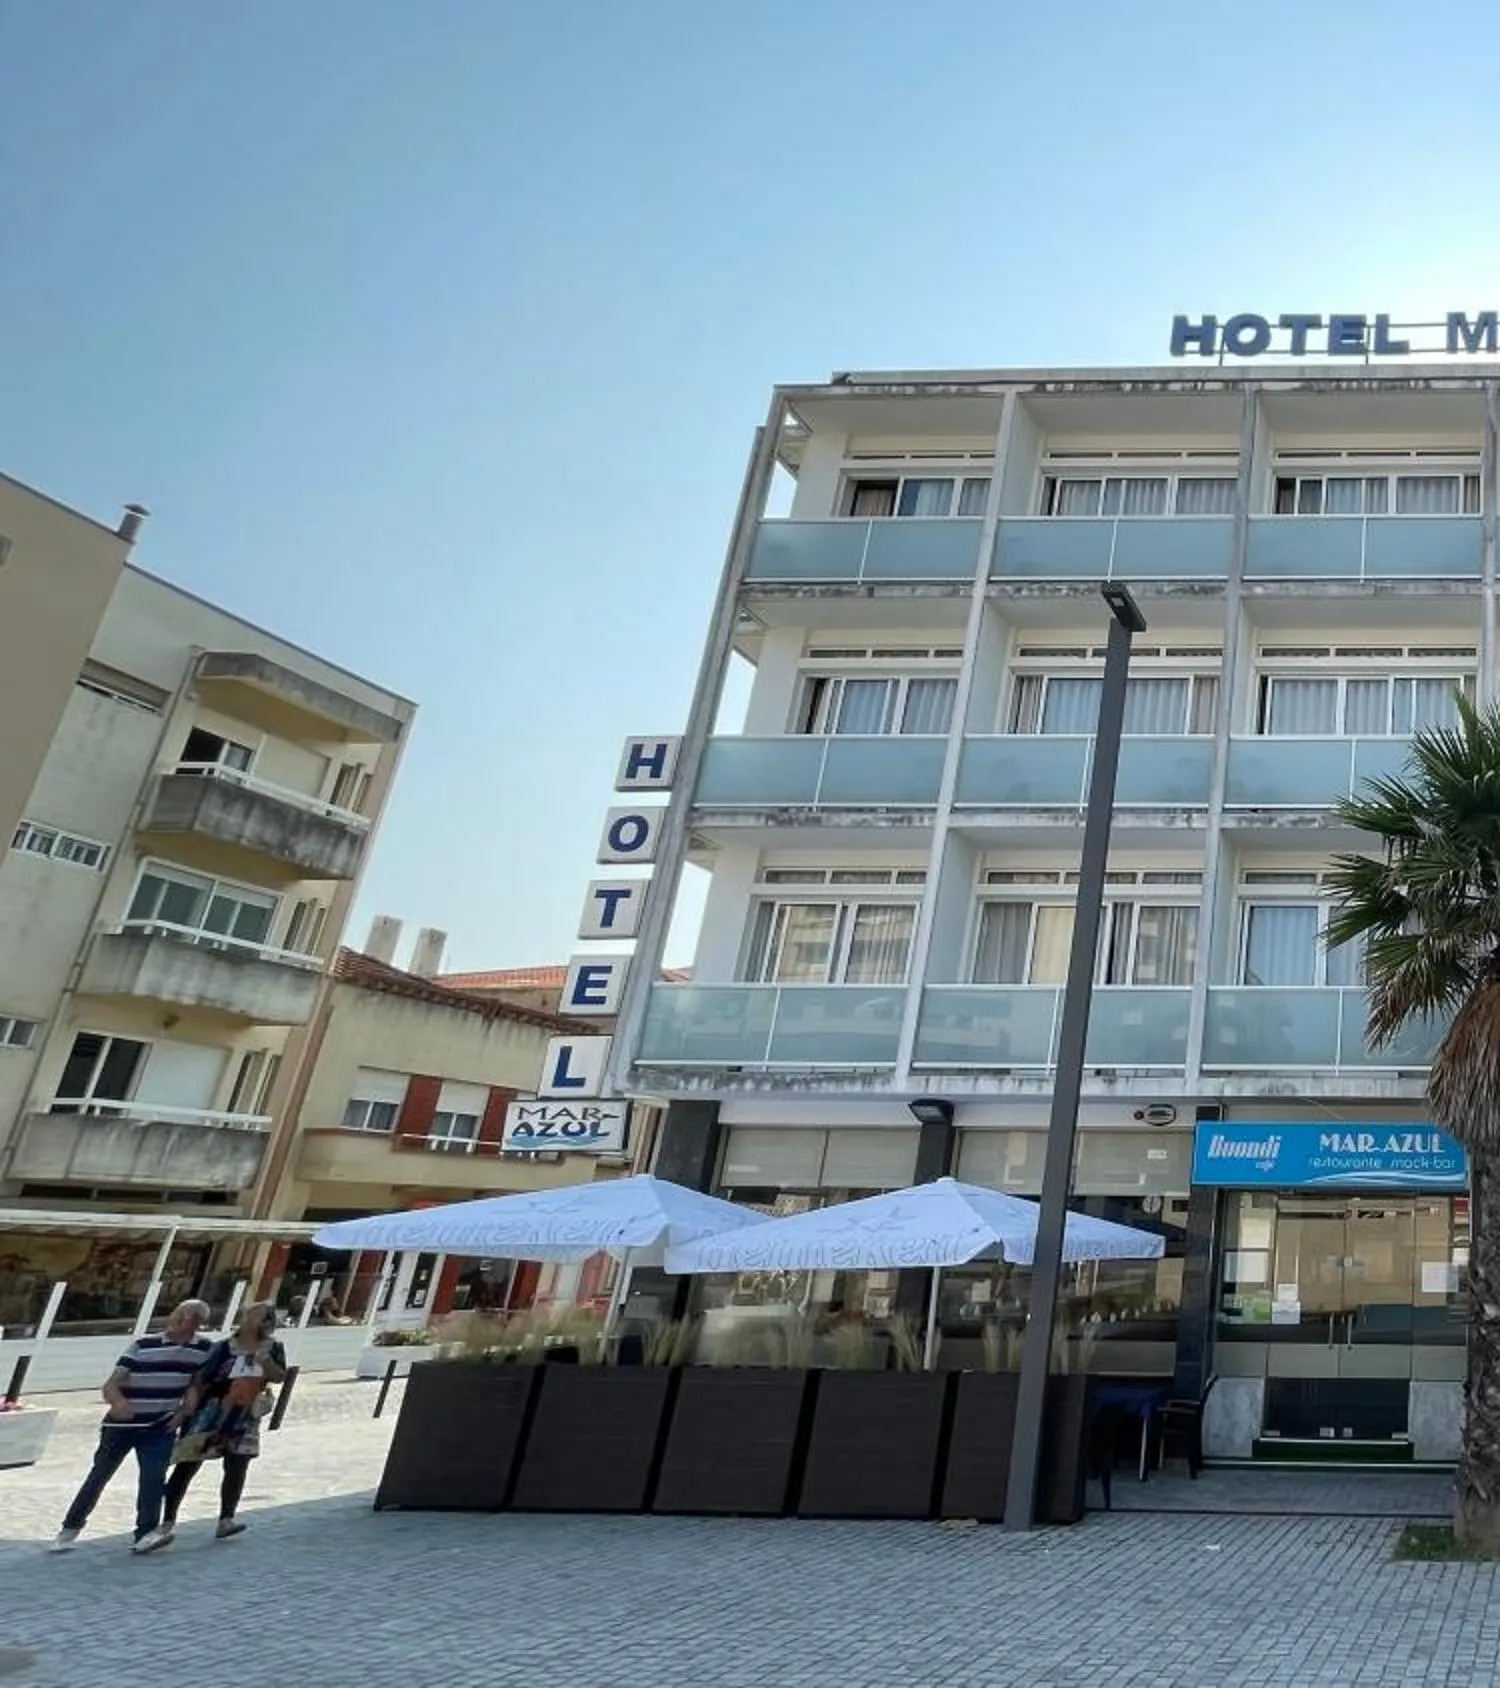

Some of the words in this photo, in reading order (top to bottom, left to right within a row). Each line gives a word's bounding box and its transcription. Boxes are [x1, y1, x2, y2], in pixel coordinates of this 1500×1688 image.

[1170, 313, 1410, 356] HOTEL
[551, 743, 667, 1089] HOTEL
[1319, 1133, 1380, 1153] MAR
[1380, 1133, 1445, 1153] AZUL
[1308, 1155, 1382, 1169] restaurante
